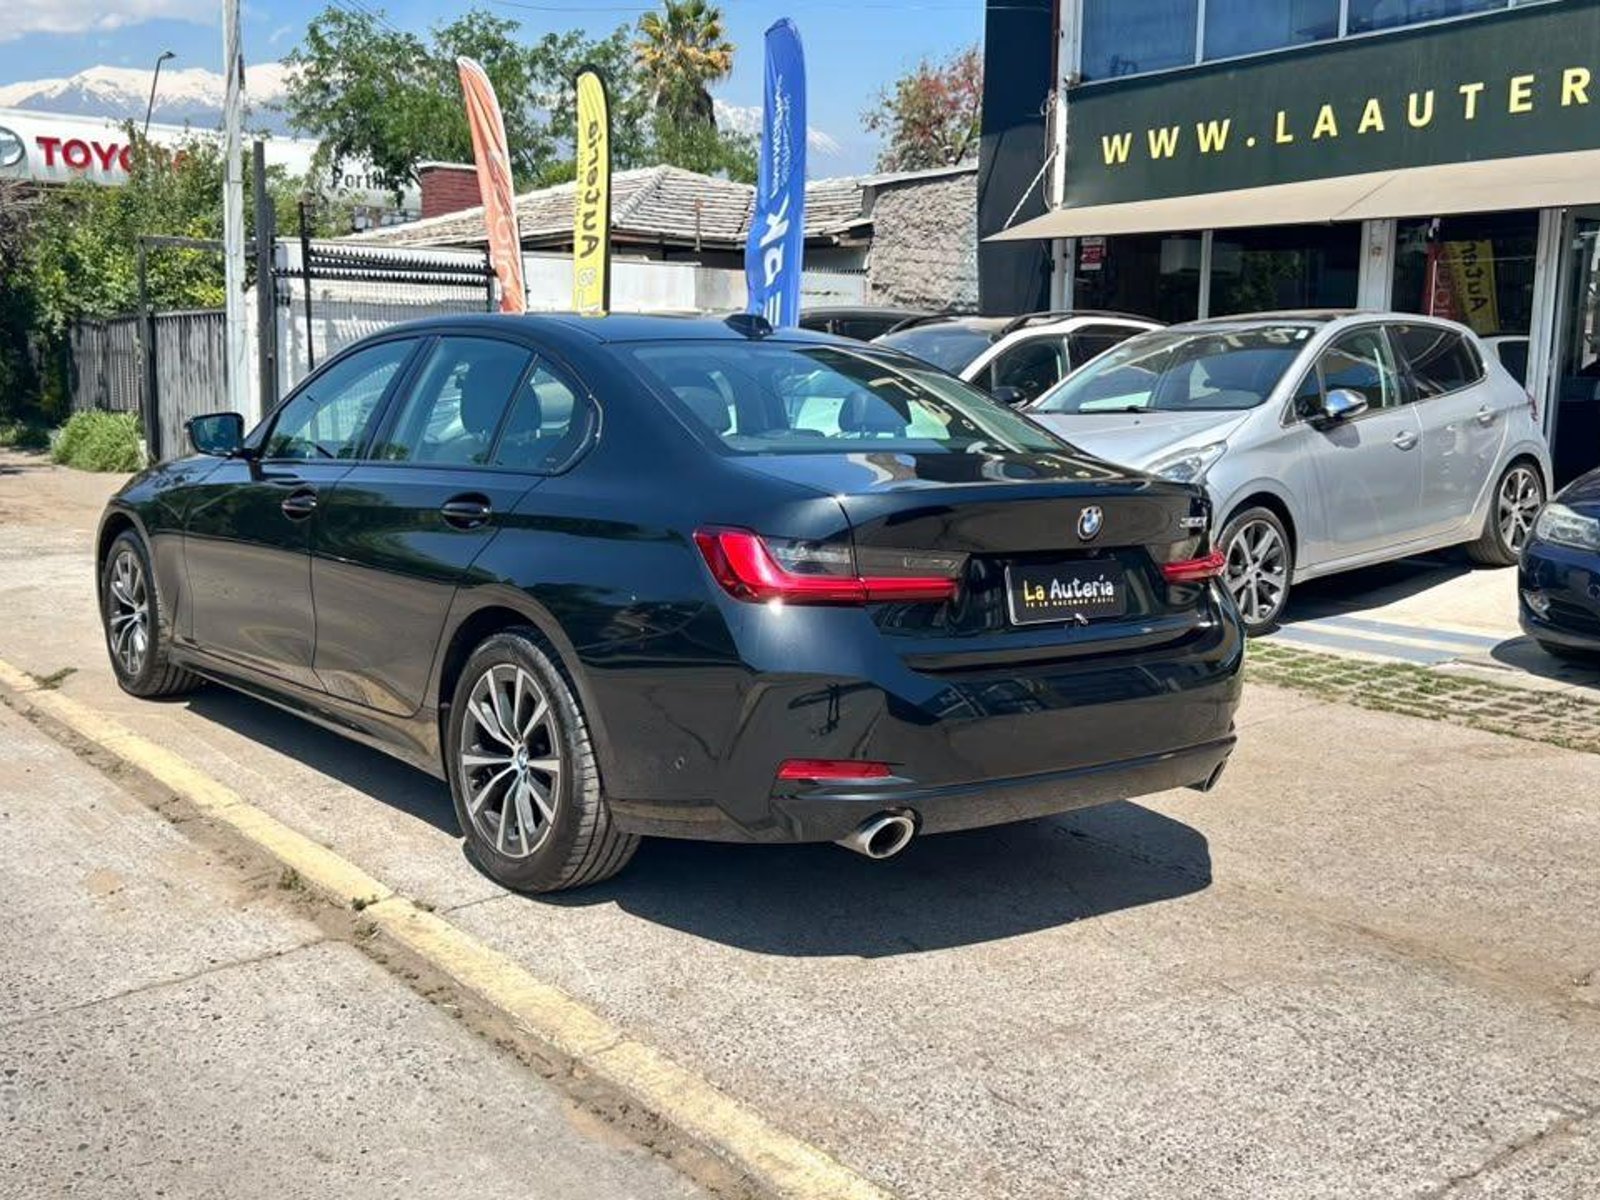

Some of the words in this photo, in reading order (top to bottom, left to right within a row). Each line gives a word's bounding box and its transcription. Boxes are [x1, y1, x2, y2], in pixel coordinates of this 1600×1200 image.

[35, 136, 189, 174] TOY
[1024, 580, 1045, 601] La
[1050, 574, 1114, 600] Autería
